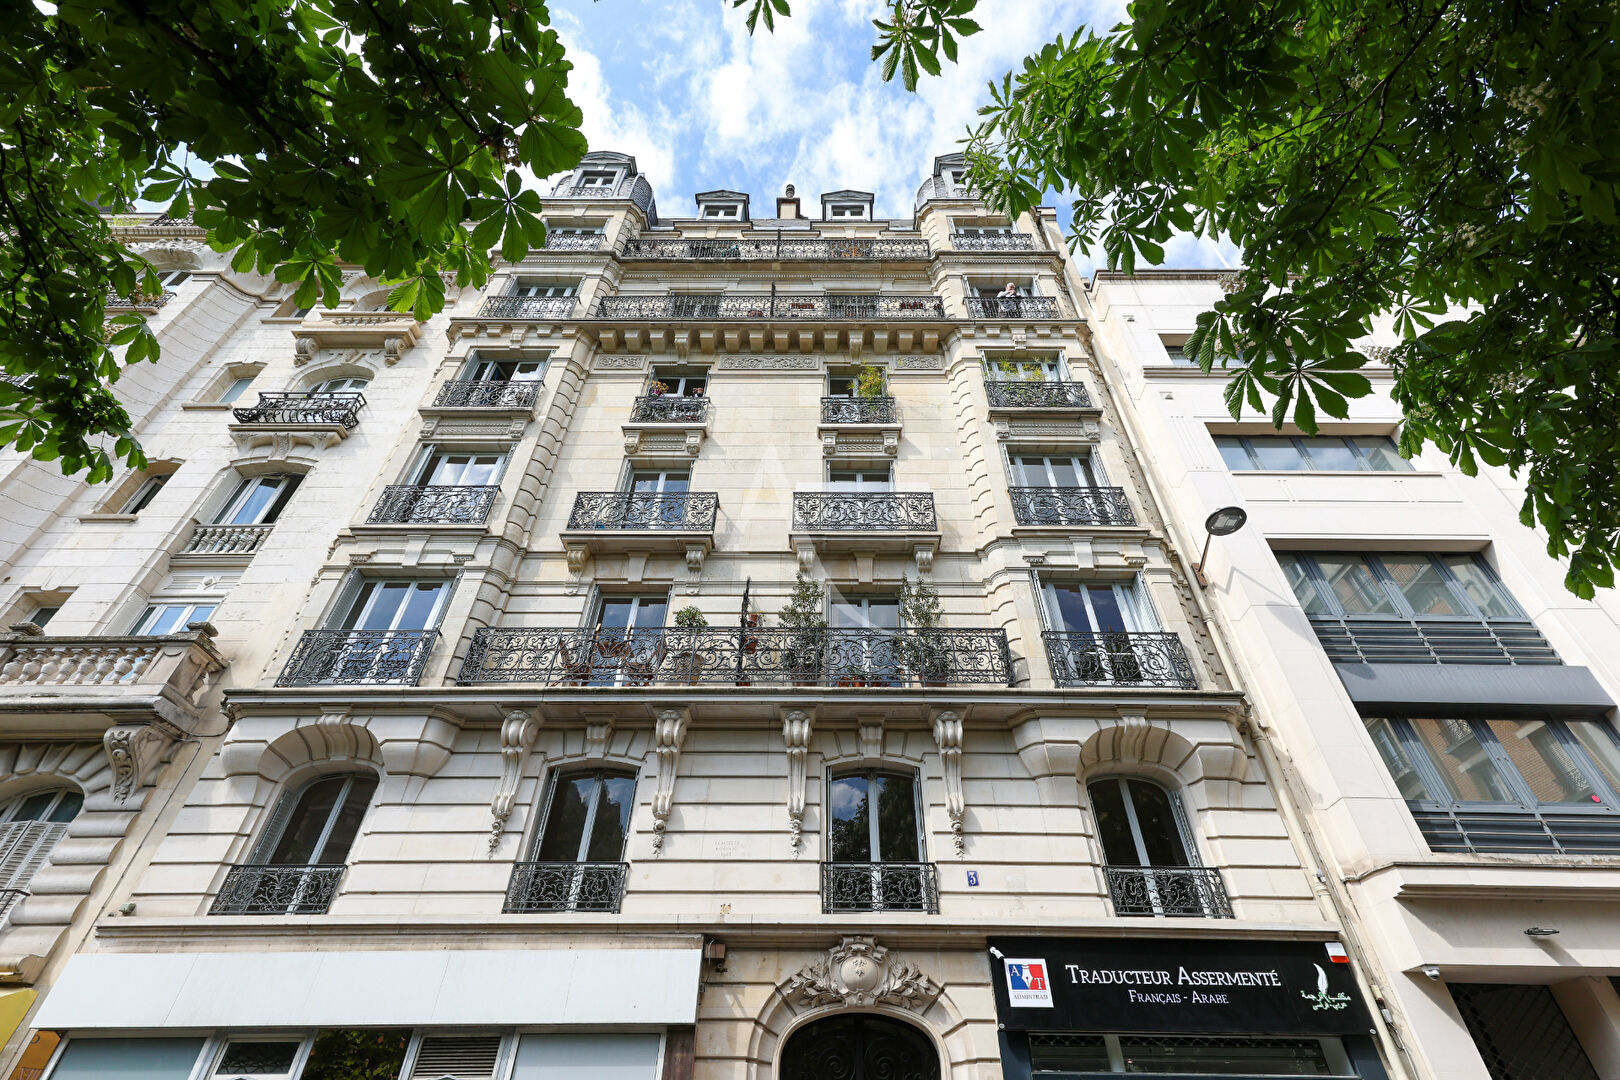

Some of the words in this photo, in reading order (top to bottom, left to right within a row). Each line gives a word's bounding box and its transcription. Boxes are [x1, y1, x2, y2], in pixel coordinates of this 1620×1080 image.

[969, 872, 977, 885] 3
[1011, 965, 1020, 976] A
[1034, 977, 1044, 990] T
[1065, 964, 1174, 986] TRADUCTEUR
[1178, 966, 1282, 987] ASSERMENTÉ
[1128, 989, 1182, 1004] FRANÇAIS
[1192, 990, 1229, 1004] ARABE
